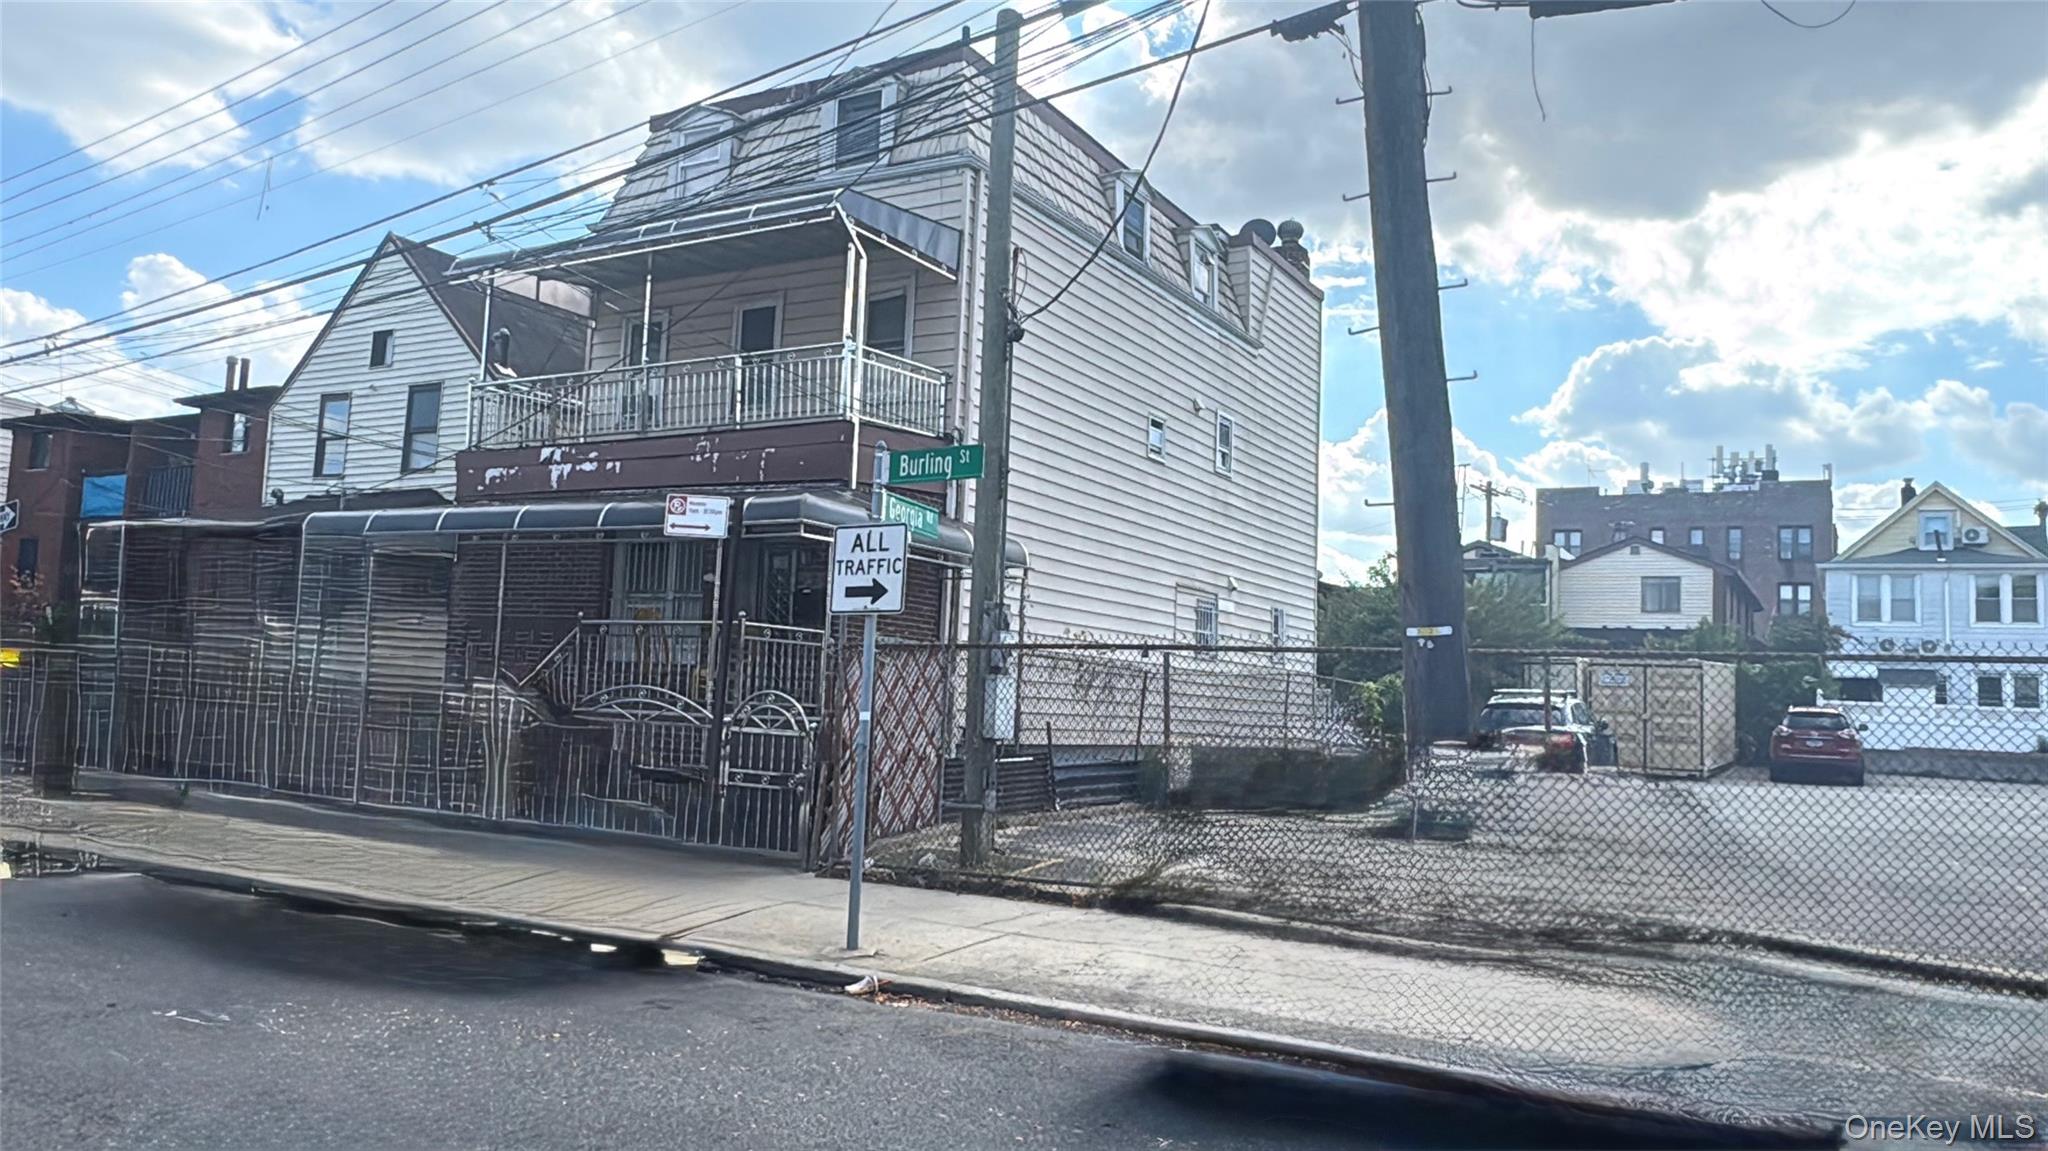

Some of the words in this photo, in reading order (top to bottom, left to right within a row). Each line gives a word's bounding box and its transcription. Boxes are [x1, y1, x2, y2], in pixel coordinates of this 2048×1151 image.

[899, 454, 953, 478] Burling
[959, 449, 971, 464] St
[889, 497, 923, 531] Georgia
[851, 530, 890, 553] ALL
[836, 557, 903, 576] TRAFFIC
